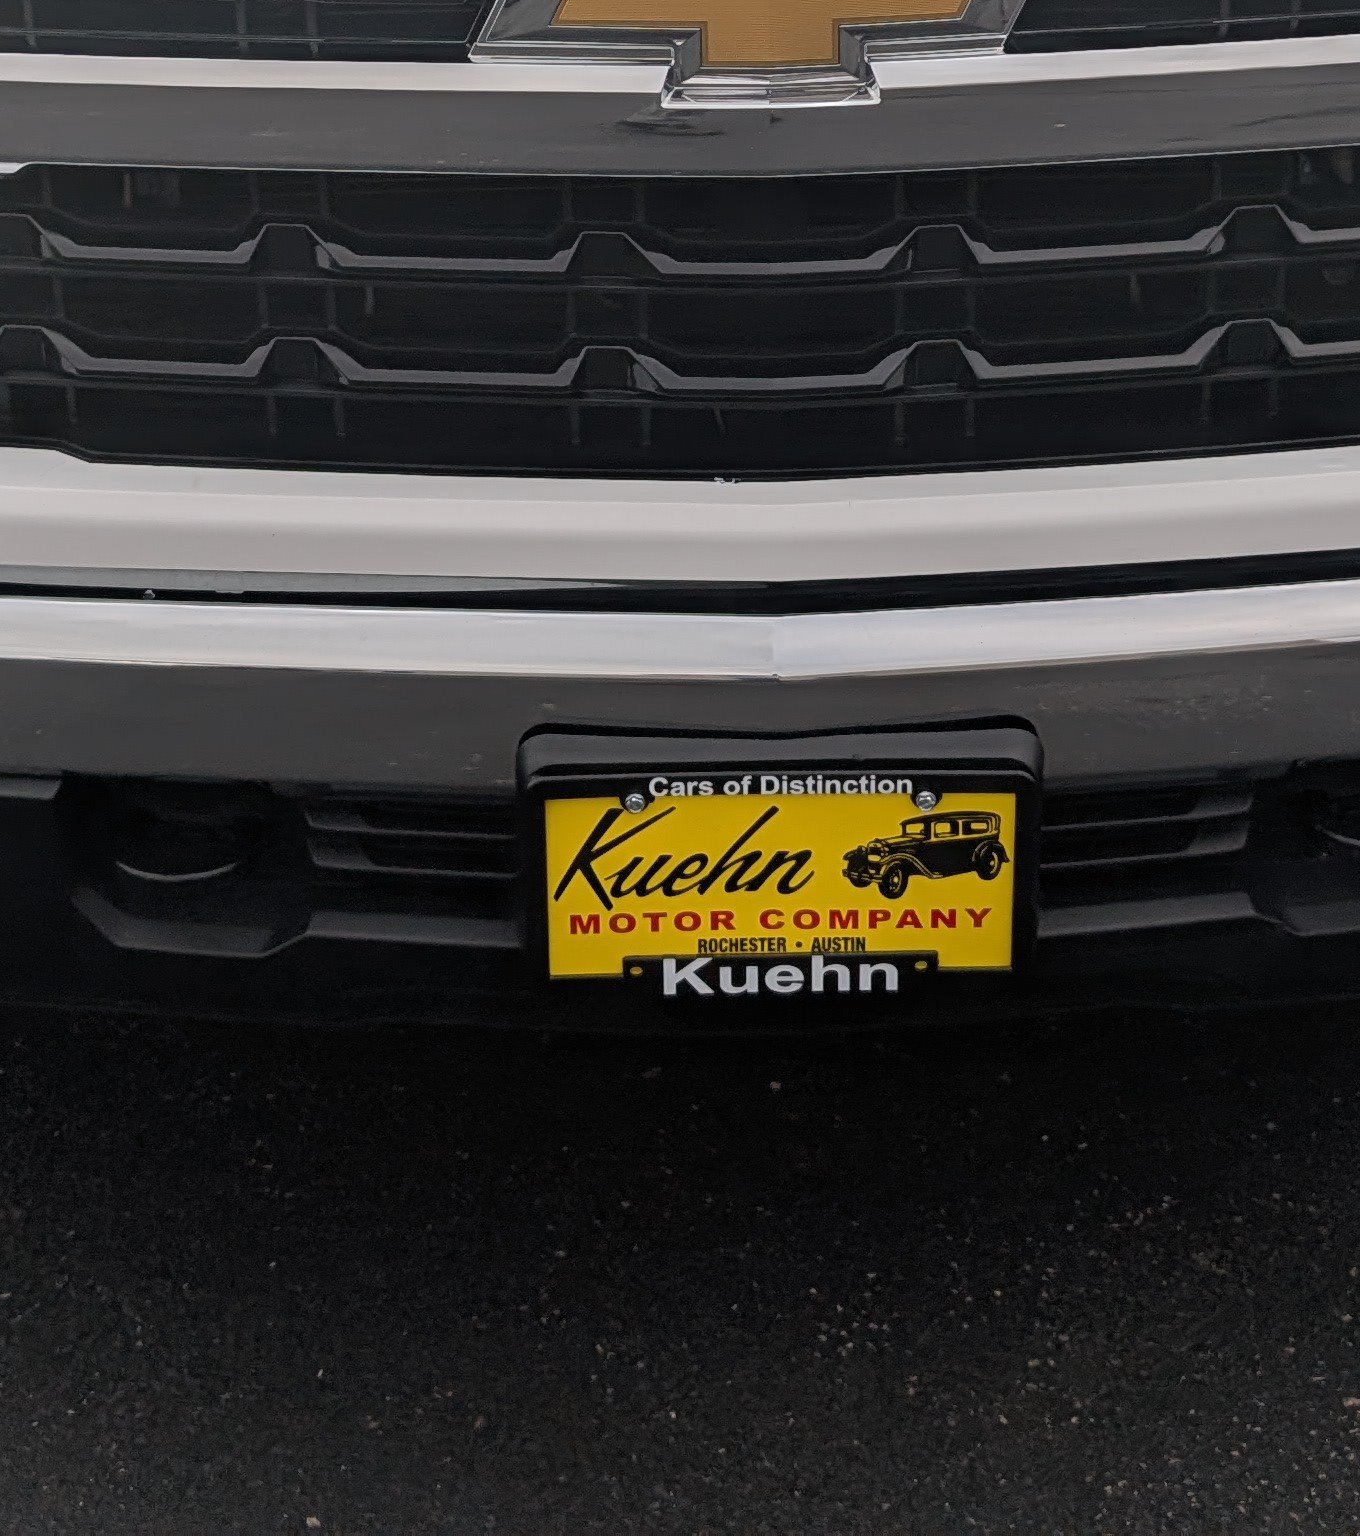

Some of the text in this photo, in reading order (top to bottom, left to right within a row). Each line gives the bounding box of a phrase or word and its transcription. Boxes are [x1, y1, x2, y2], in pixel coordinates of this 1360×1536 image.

[648, 774, 914, 797] Cars of Distinction
[553, 805, 815, 911] Kuehn
[568, 908, 993, 935] MOTOR COMPANY
[697, 936, 867, 954] ROCHESTER AUSTIN
[661, 955, 900, 996] Kuehn
